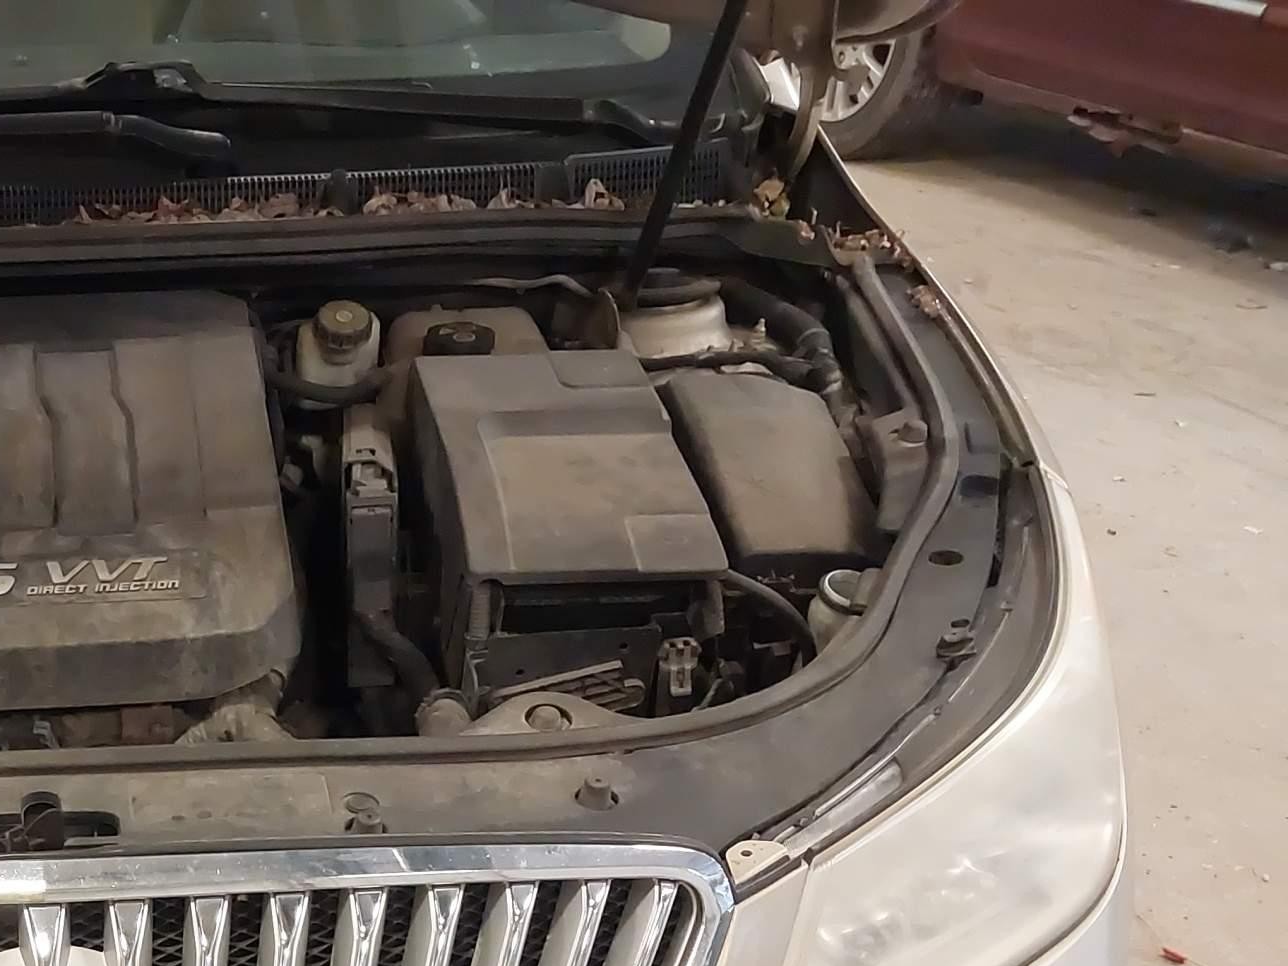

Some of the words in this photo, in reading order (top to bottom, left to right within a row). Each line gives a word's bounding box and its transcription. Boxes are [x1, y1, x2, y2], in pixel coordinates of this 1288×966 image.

[45, 556, 169, 583] VVT
[26, 583, 88, 596] DIRECT
[94, 579, 180, 594] INJECTION
